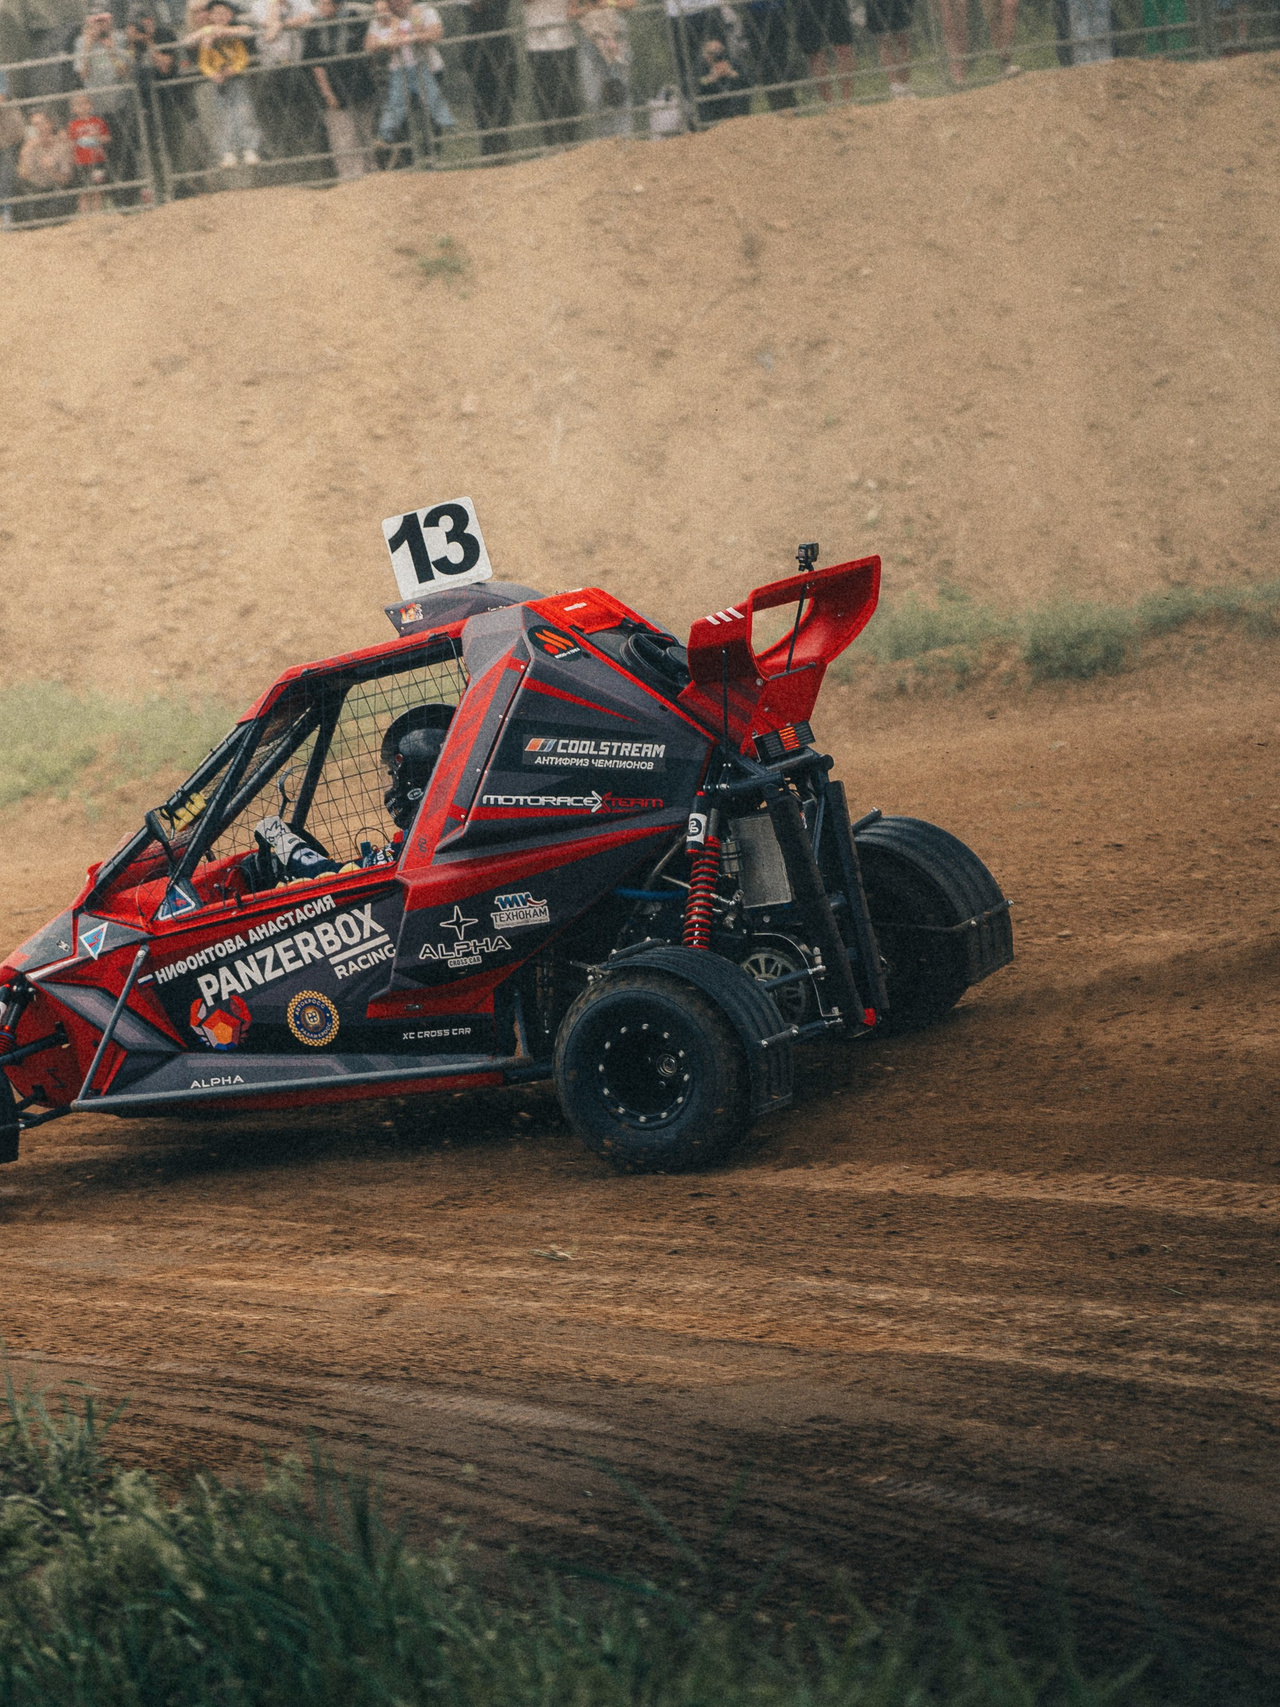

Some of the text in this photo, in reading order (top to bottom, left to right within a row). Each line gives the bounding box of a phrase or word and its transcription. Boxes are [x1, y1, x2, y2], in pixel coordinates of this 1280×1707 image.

[388, 503, 480, 584] 13
[556, 739, 666, 758] COOLSTREAM
[534, 756, 654, 770] АНТИФРИЗ ЧЕМПИОНОВ
[154, 894, 337, 985] НИФОНТОВА АНАСТАСИЯ
[419, 935, 512, 960] ALPHA
[196, 902, 386, 1007] PANZERBOX
[333, 943, 397, 980] RACING
[448, 956, 482, 967] CROSS CAR
[402, 1027, 472, 1040] XC CROSS CAR
[190, 1074, 245, 1089] ALPHA
